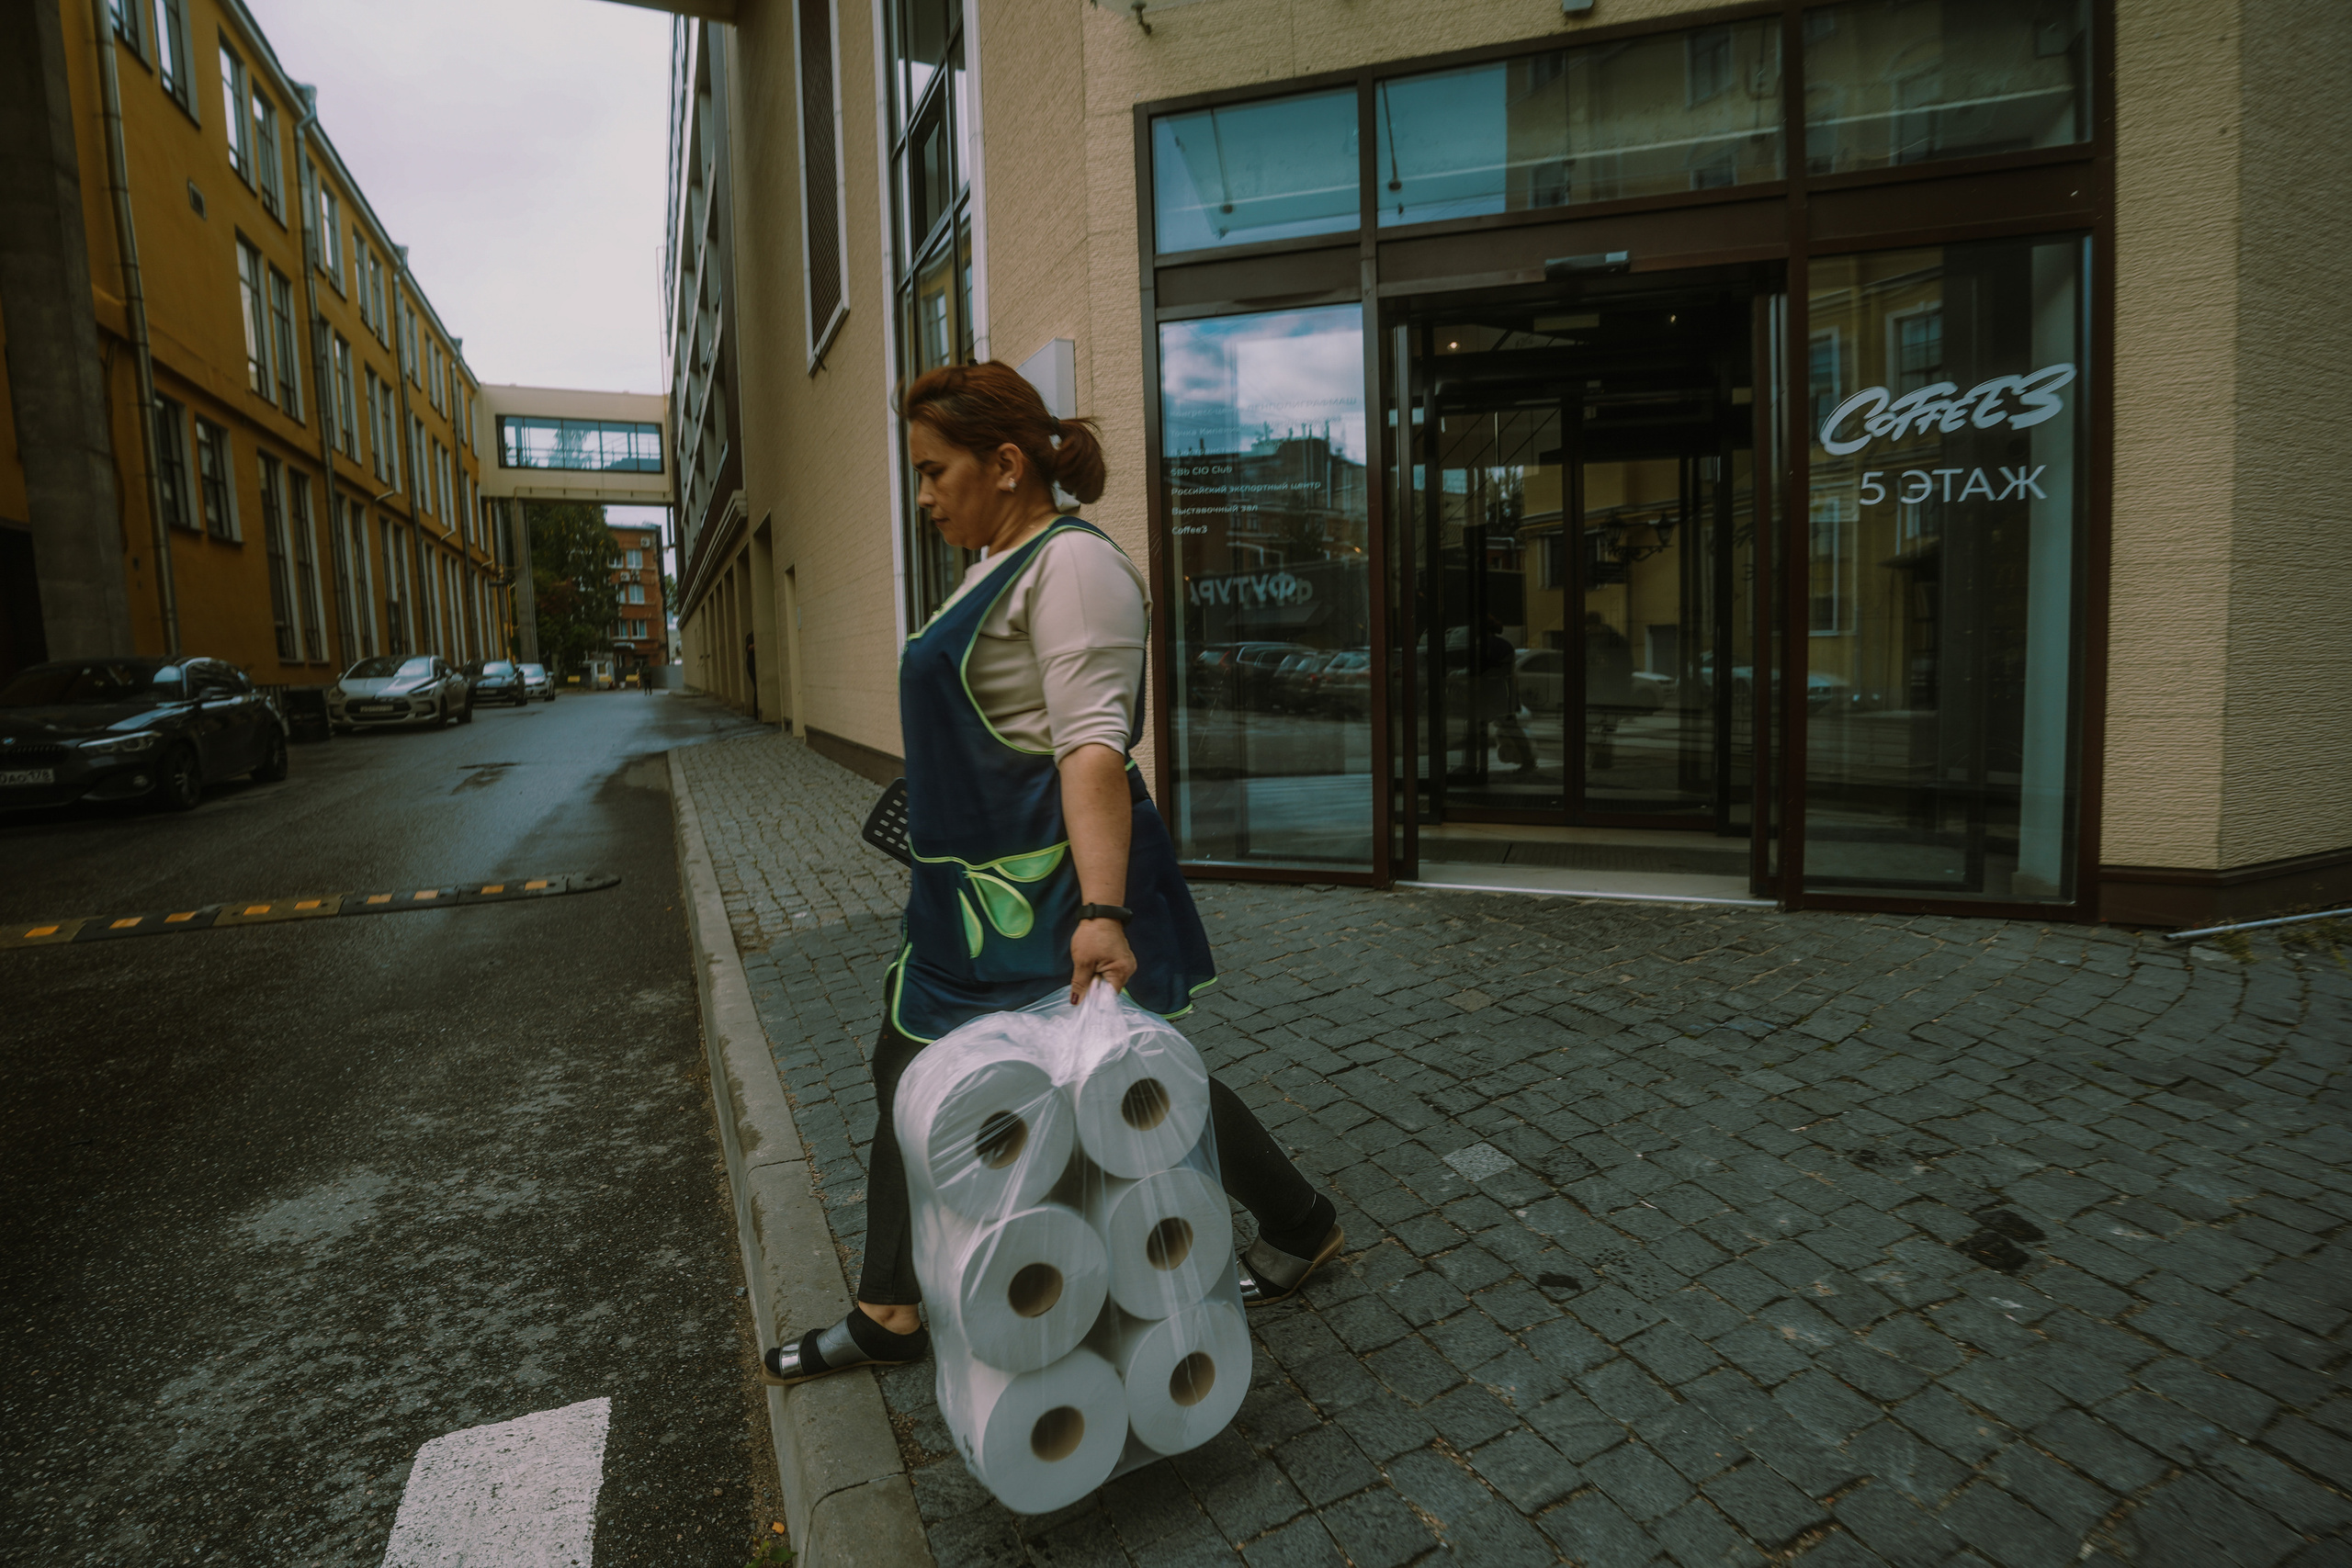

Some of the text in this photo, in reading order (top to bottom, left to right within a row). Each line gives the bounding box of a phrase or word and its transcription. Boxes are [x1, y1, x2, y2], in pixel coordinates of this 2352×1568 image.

[1212, 465, 1233, 475] Club
[1170, 480, 1322, 496] Российский экспортный центр
[1859, 464, 2048, 505] 5 ЭТАЖ
[1171, 504, 1259, 515] Выставочный зал
[1171, 525, 1208, 536] Coffee3
